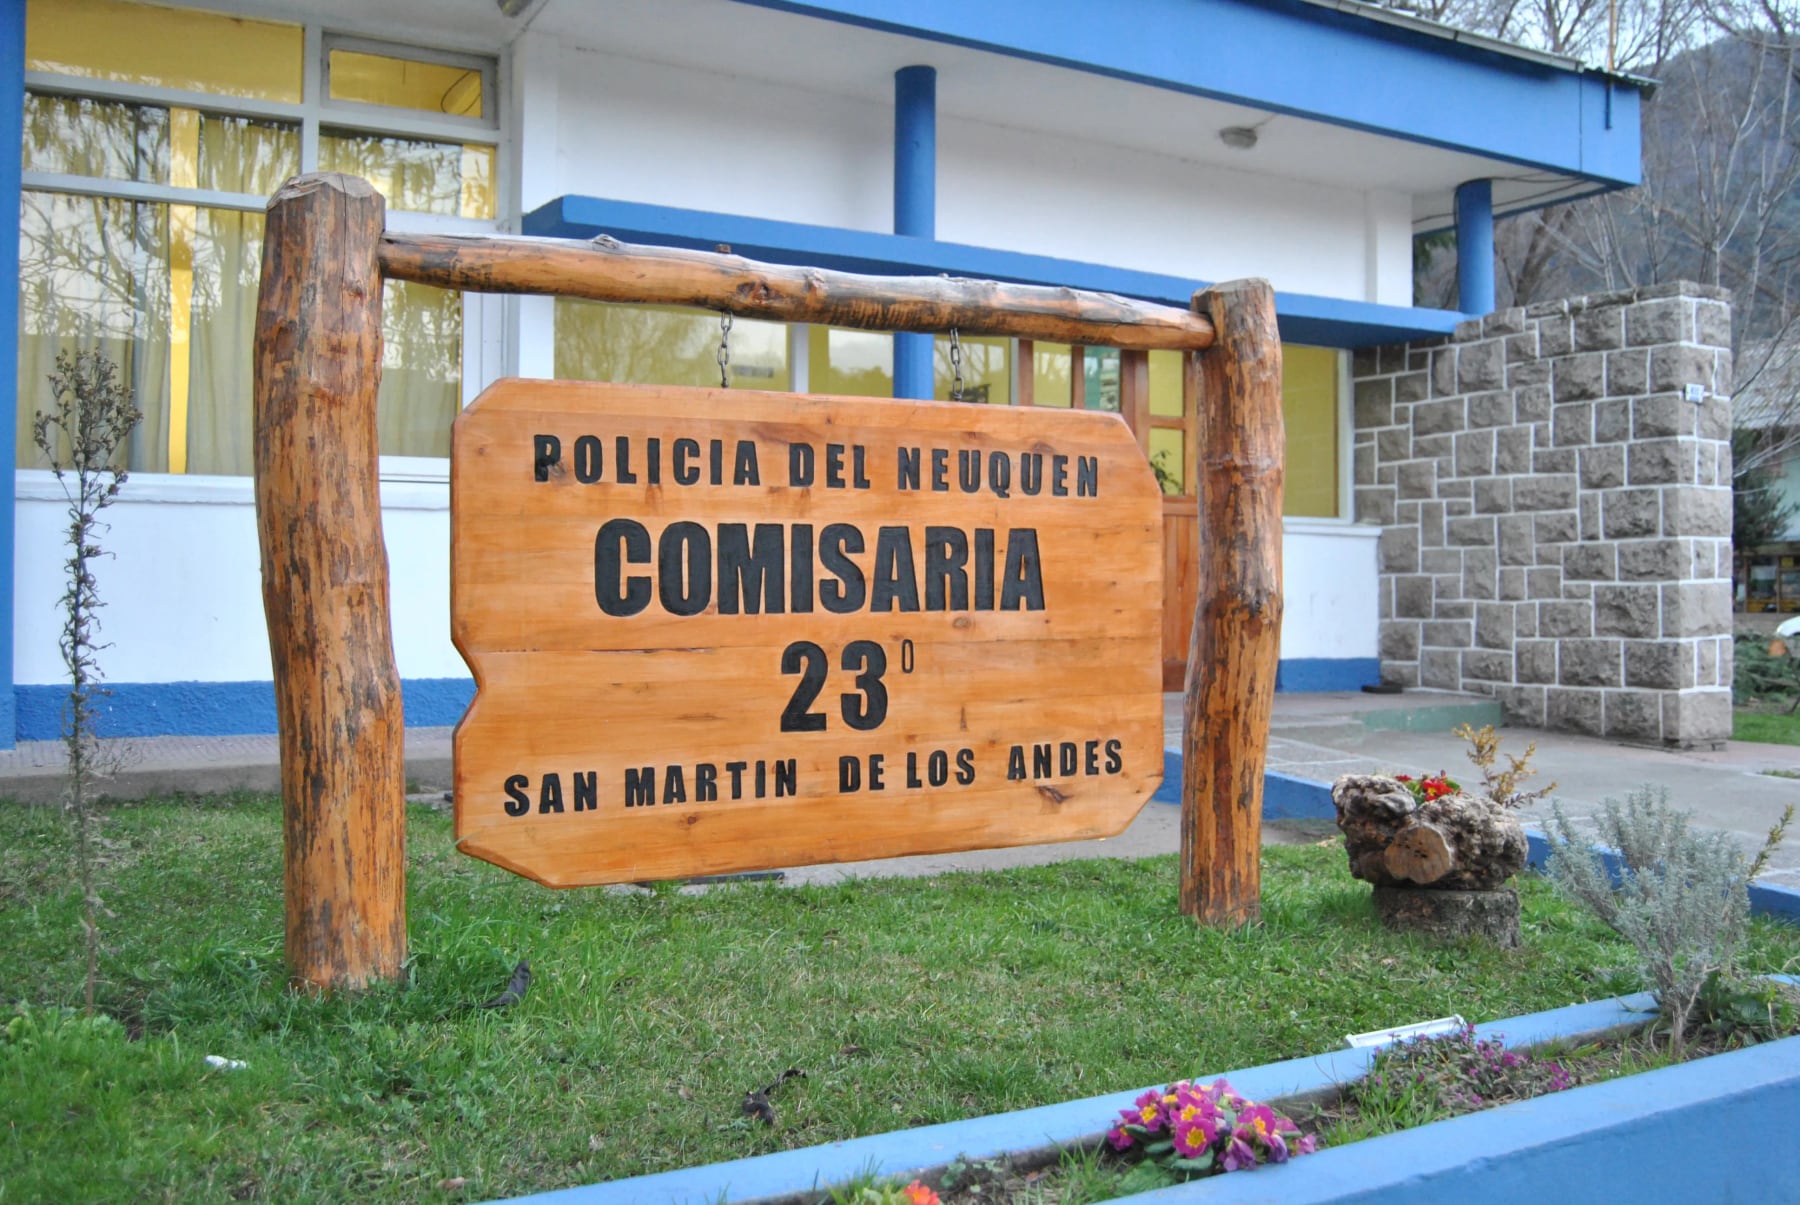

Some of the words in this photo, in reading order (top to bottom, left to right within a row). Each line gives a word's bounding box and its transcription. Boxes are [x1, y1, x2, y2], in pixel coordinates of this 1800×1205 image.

[533, 434, 761, 486] POLICIA
[788, 442, 871, 490] DEL
[897, 446, 1099, 498] NEUQUEN
[594, 518, 1046, 617] COMISARIA
[503, 771, 599, 817] SAN
[623, 758, 798, 808] MARTIN
[838, 753, 886, 794] DE
[905, 748, 977, 789] LOS
[1006, 739, 1124, 782] ANDES
